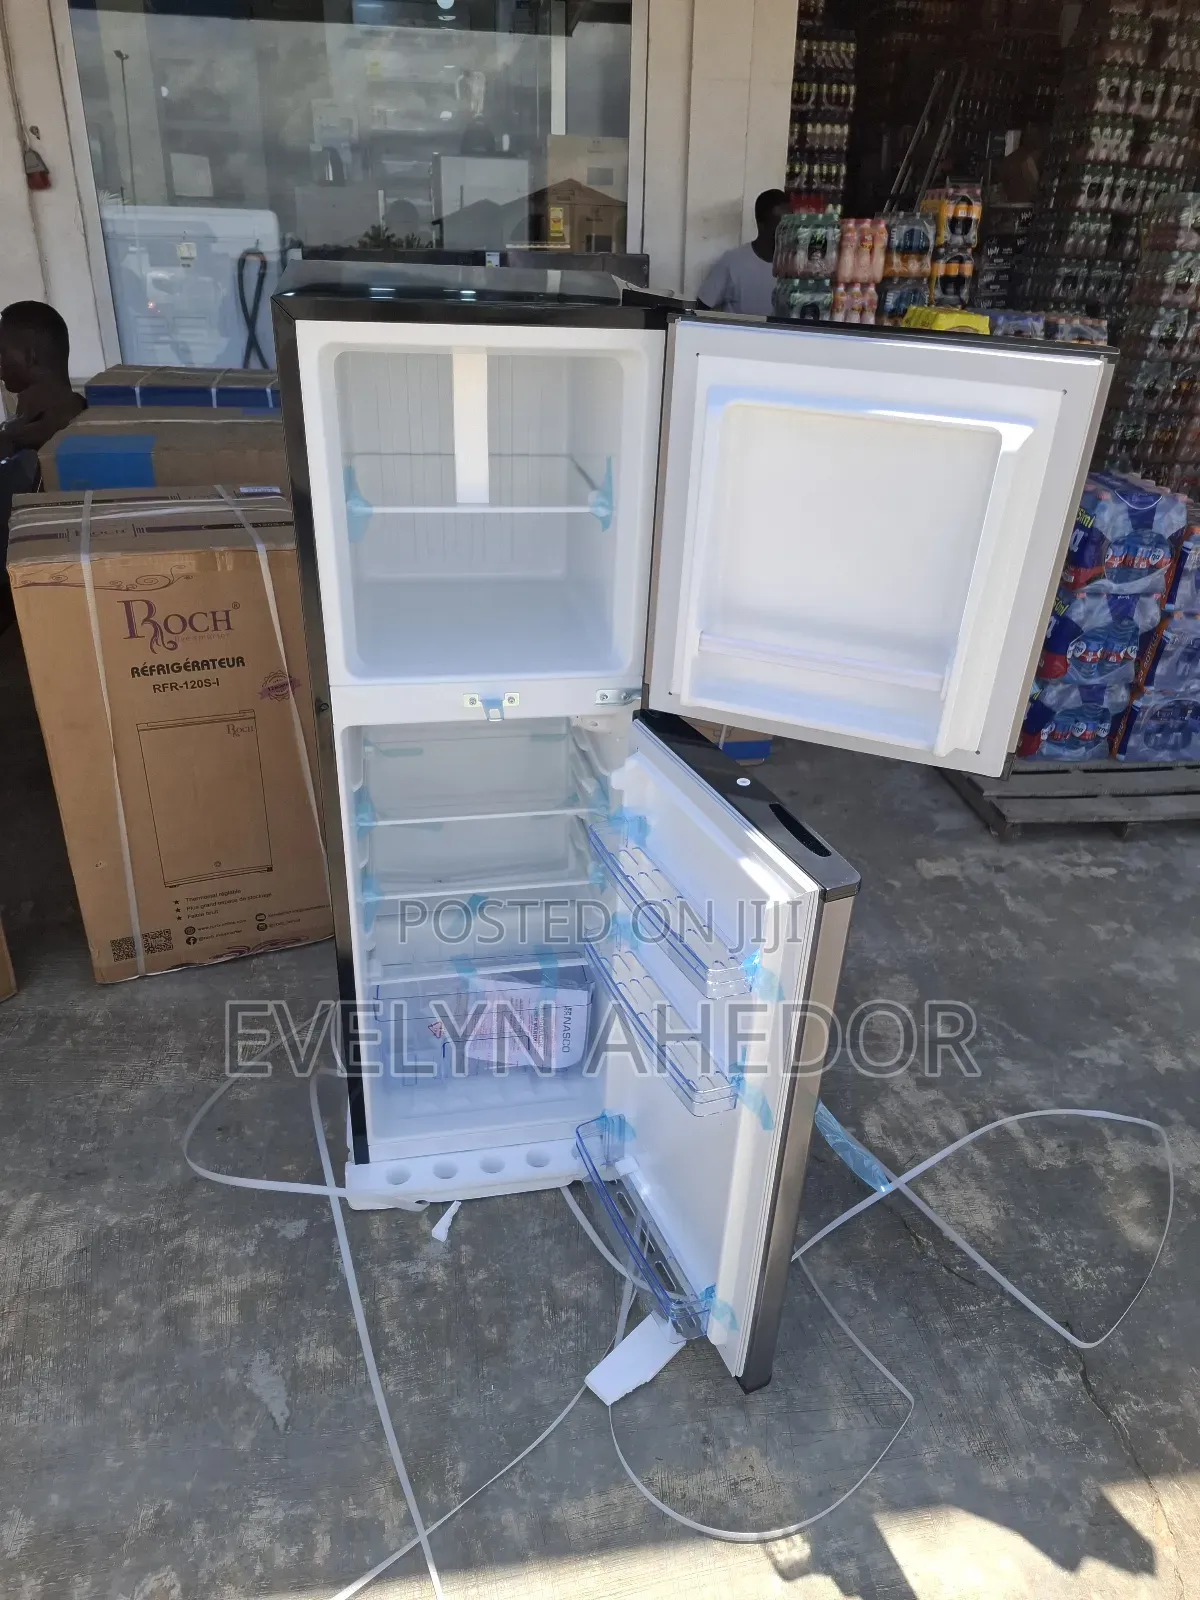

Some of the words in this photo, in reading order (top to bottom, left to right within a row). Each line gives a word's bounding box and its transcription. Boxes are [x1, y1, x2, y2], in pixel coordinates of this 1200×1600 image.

[117, 599, 235, 654] ROCH
[130, 655, 246, 679] RÉFRIGÉRATEUR
[152, 677, 220, 694] RFR-120S-I
